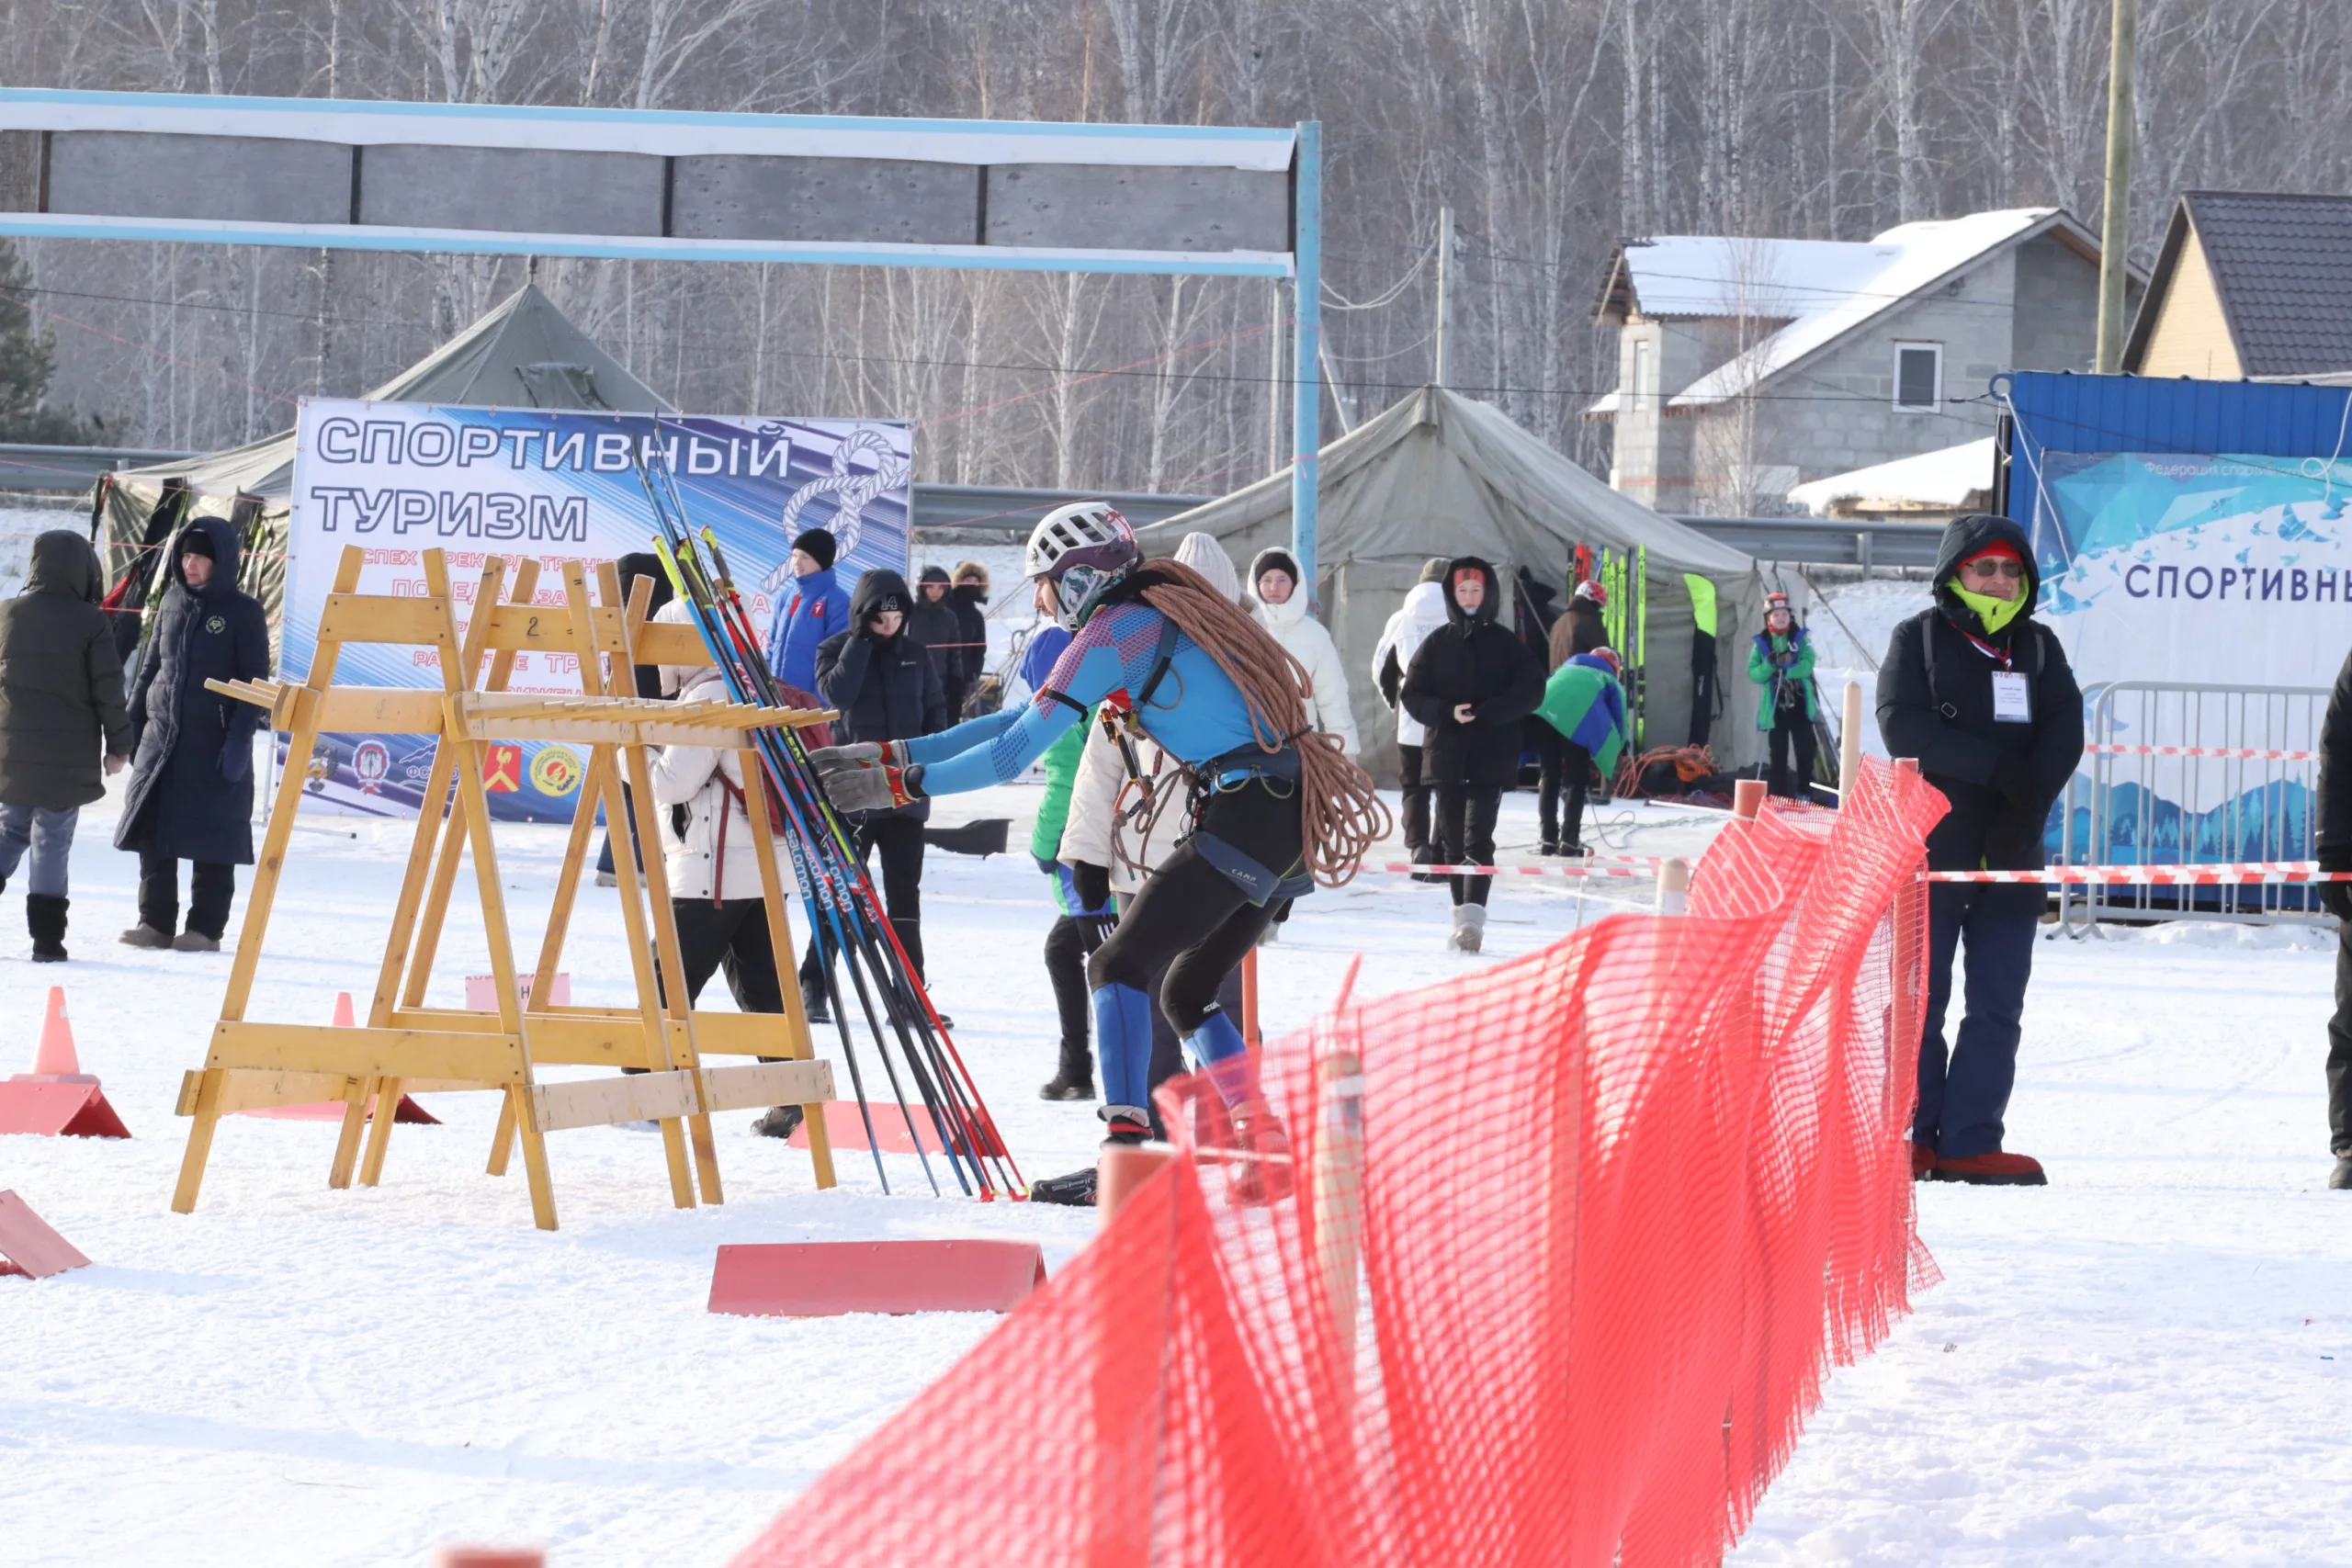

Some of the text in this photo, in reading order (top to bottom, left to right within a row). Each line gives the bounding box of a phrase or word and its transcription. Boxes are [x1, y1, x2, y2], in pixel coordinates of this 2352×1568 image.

[317, 416, 793, 479] СПОРТИВНЫЙ
[311, 486, 588, 543] ТУРИЗМ
[526, 616, 540, 637] 2
